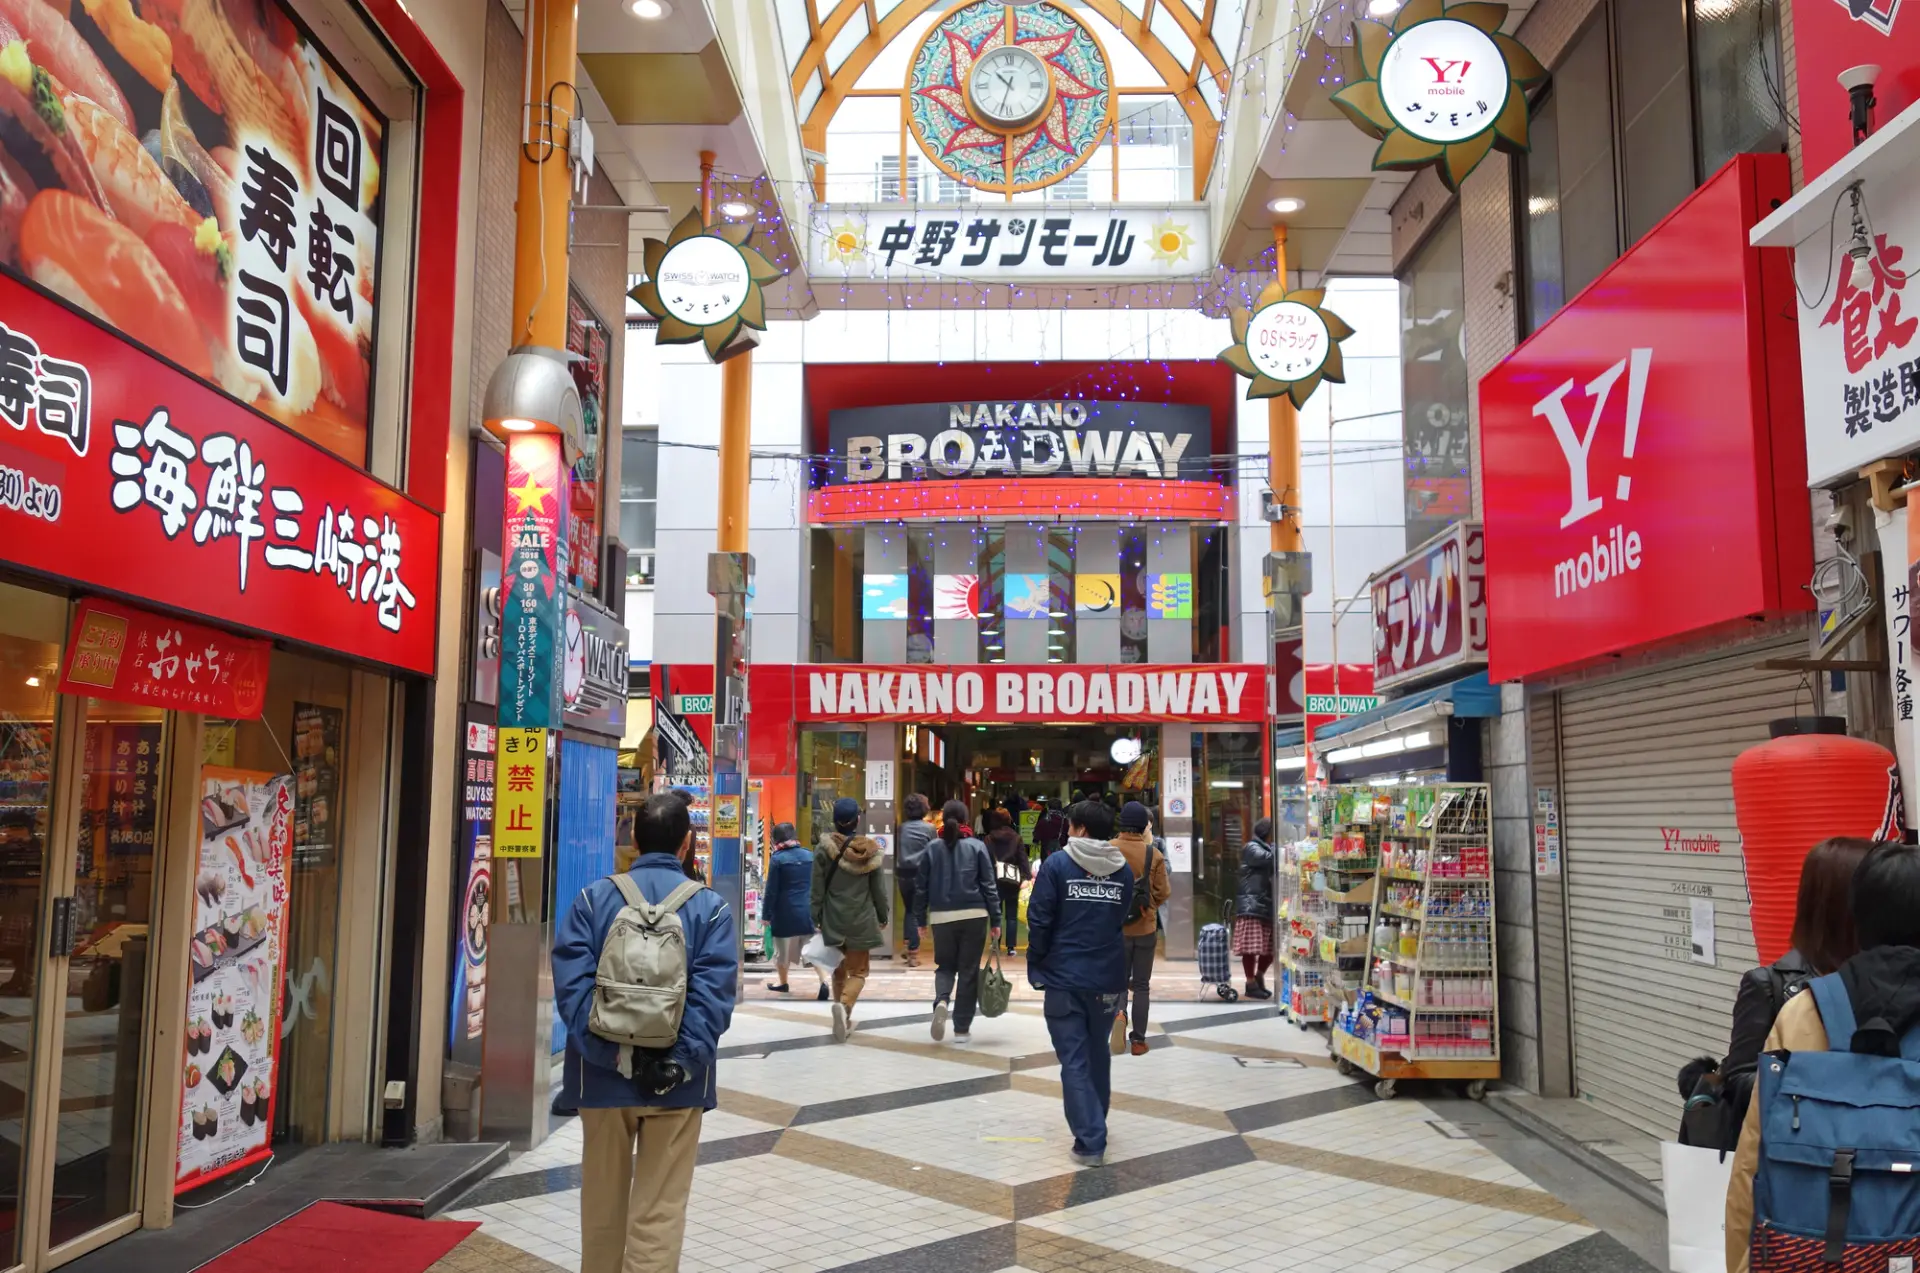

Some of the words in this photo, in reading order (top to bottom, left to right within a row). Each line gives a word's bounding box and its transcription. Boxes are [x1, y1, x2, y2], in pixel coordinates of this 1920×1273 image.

[1420, 57, 1472, 83] Y!
[1428, 87, 1466, 95] mobile
[1406, 100, 1488, 127] サンモール
[308, 87, 361, 324] 回転
[877, 218, 1136, 268] 中野サンモール
[237, 145, 299, 397] 寿司
[664, 272, 694, 280] SWISS
[709, 272, 740, 280] WATCH
[672, 294, 731, 315] サンモール
[1274, 314, 1307, 326] クスリ
[949, 402, 1087, 429] NAKANO
[1532, 348, 1653, 529] Y!
[846, 428, 1192, 482] BROADWAY
[110, 407, 416, 633] 海鮮三崎港
[511, 524, 550, 532] Christmas
[511, 533, 550, 548] SALE
[1553, 523, 1642, 598] mobile
[523, 583, 535, 592] 80
[520, 599, 537, 608] 160
[147, 628, 220, 685] おせち
[583, 631, 630, 695] WATCH
[1892, 584, 1913, 722] サワー各種
[809, 672, 984, 715] NAKANO
[996, 671, 1248, 714] BROADWAY
[505, 764, 535, 831] 禁止
[500, 845, 536, 853] 中野警察署
[1661, 827, 1681, 852] Y!
[1681, 833, 1721, 854] mobile
[1068, 883, 1122, 900] Reebok
